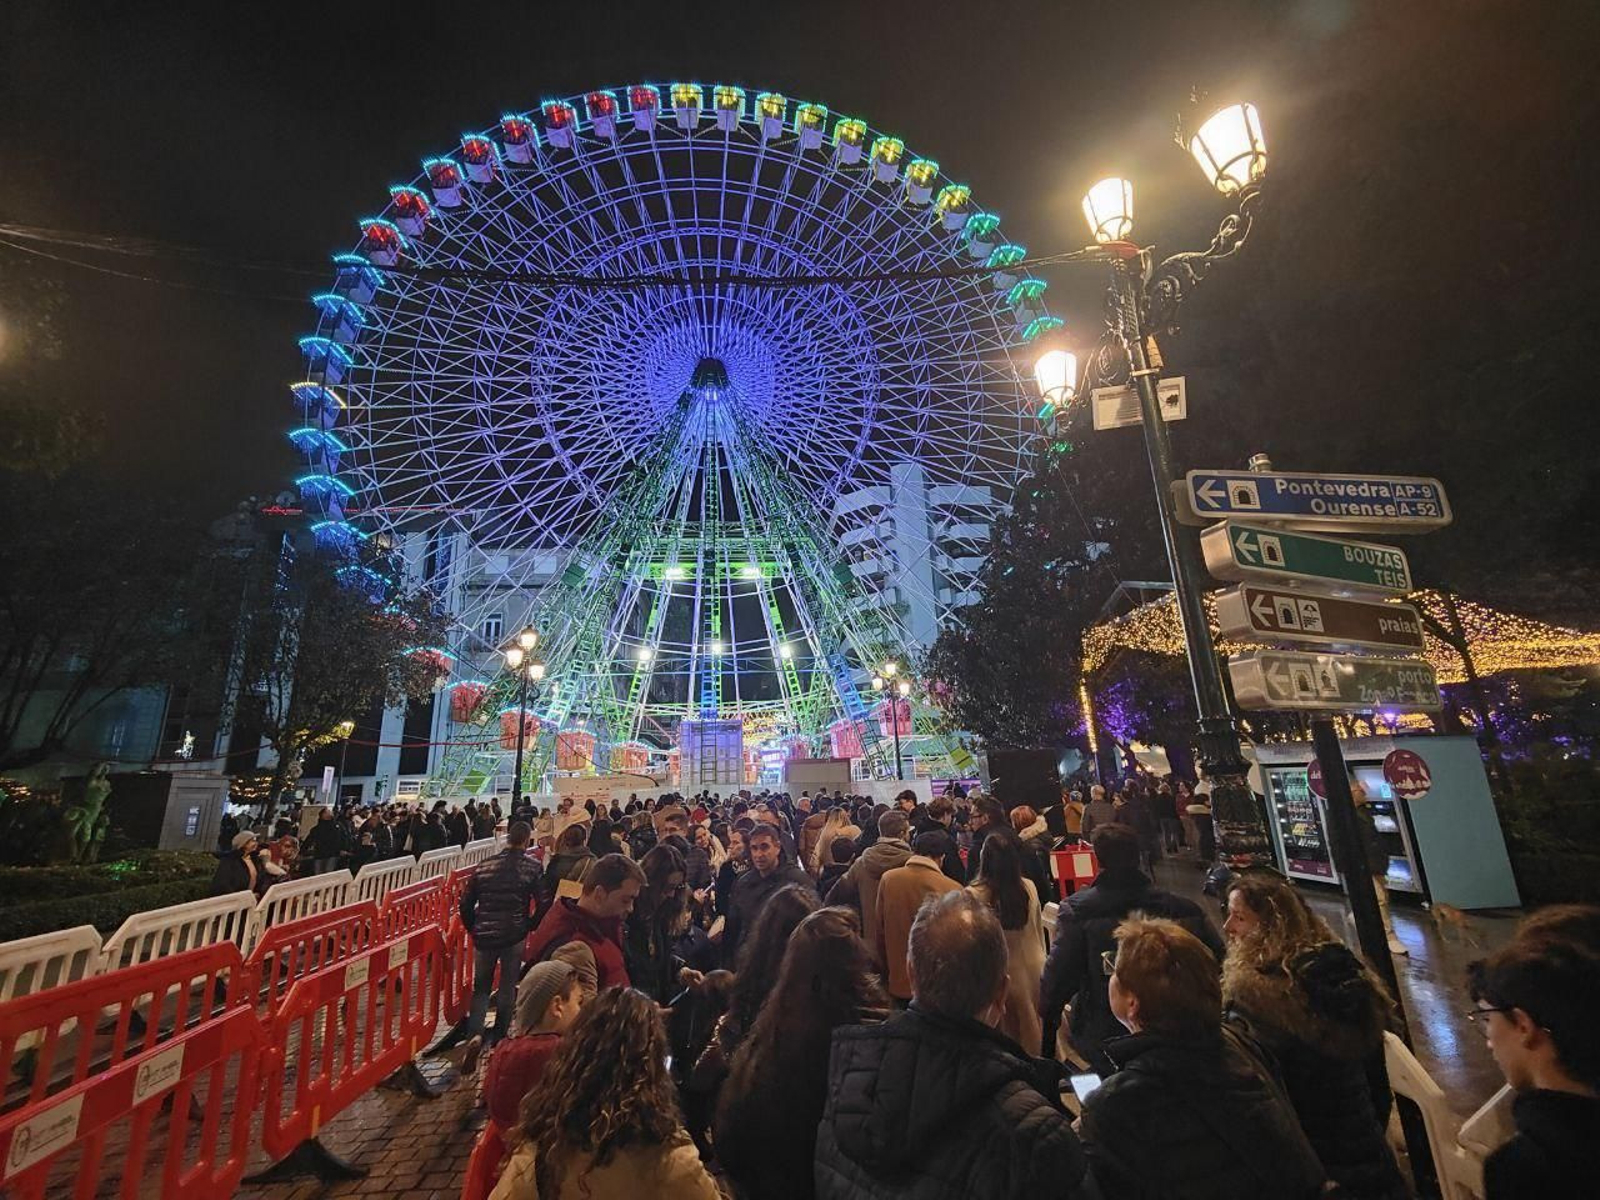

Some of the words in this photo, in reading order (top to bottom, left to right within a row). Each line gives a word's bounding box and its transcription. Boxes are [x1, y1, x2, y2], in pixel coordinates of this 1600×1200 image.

[1274, 478, 1391, 498] Pontevedra
[1396, 485, 1433, 498] AP-9
[1311, 498, 1397, 515] Ourense
[1400, 503, 1438, 516] A-52
[1343, 546, 1403, 570] BOUZAS
[1375, 570, 1407, 587] TEIS
[1378, 617, 1418, 635] praias
[1398, 668, 1432, 687] porto
